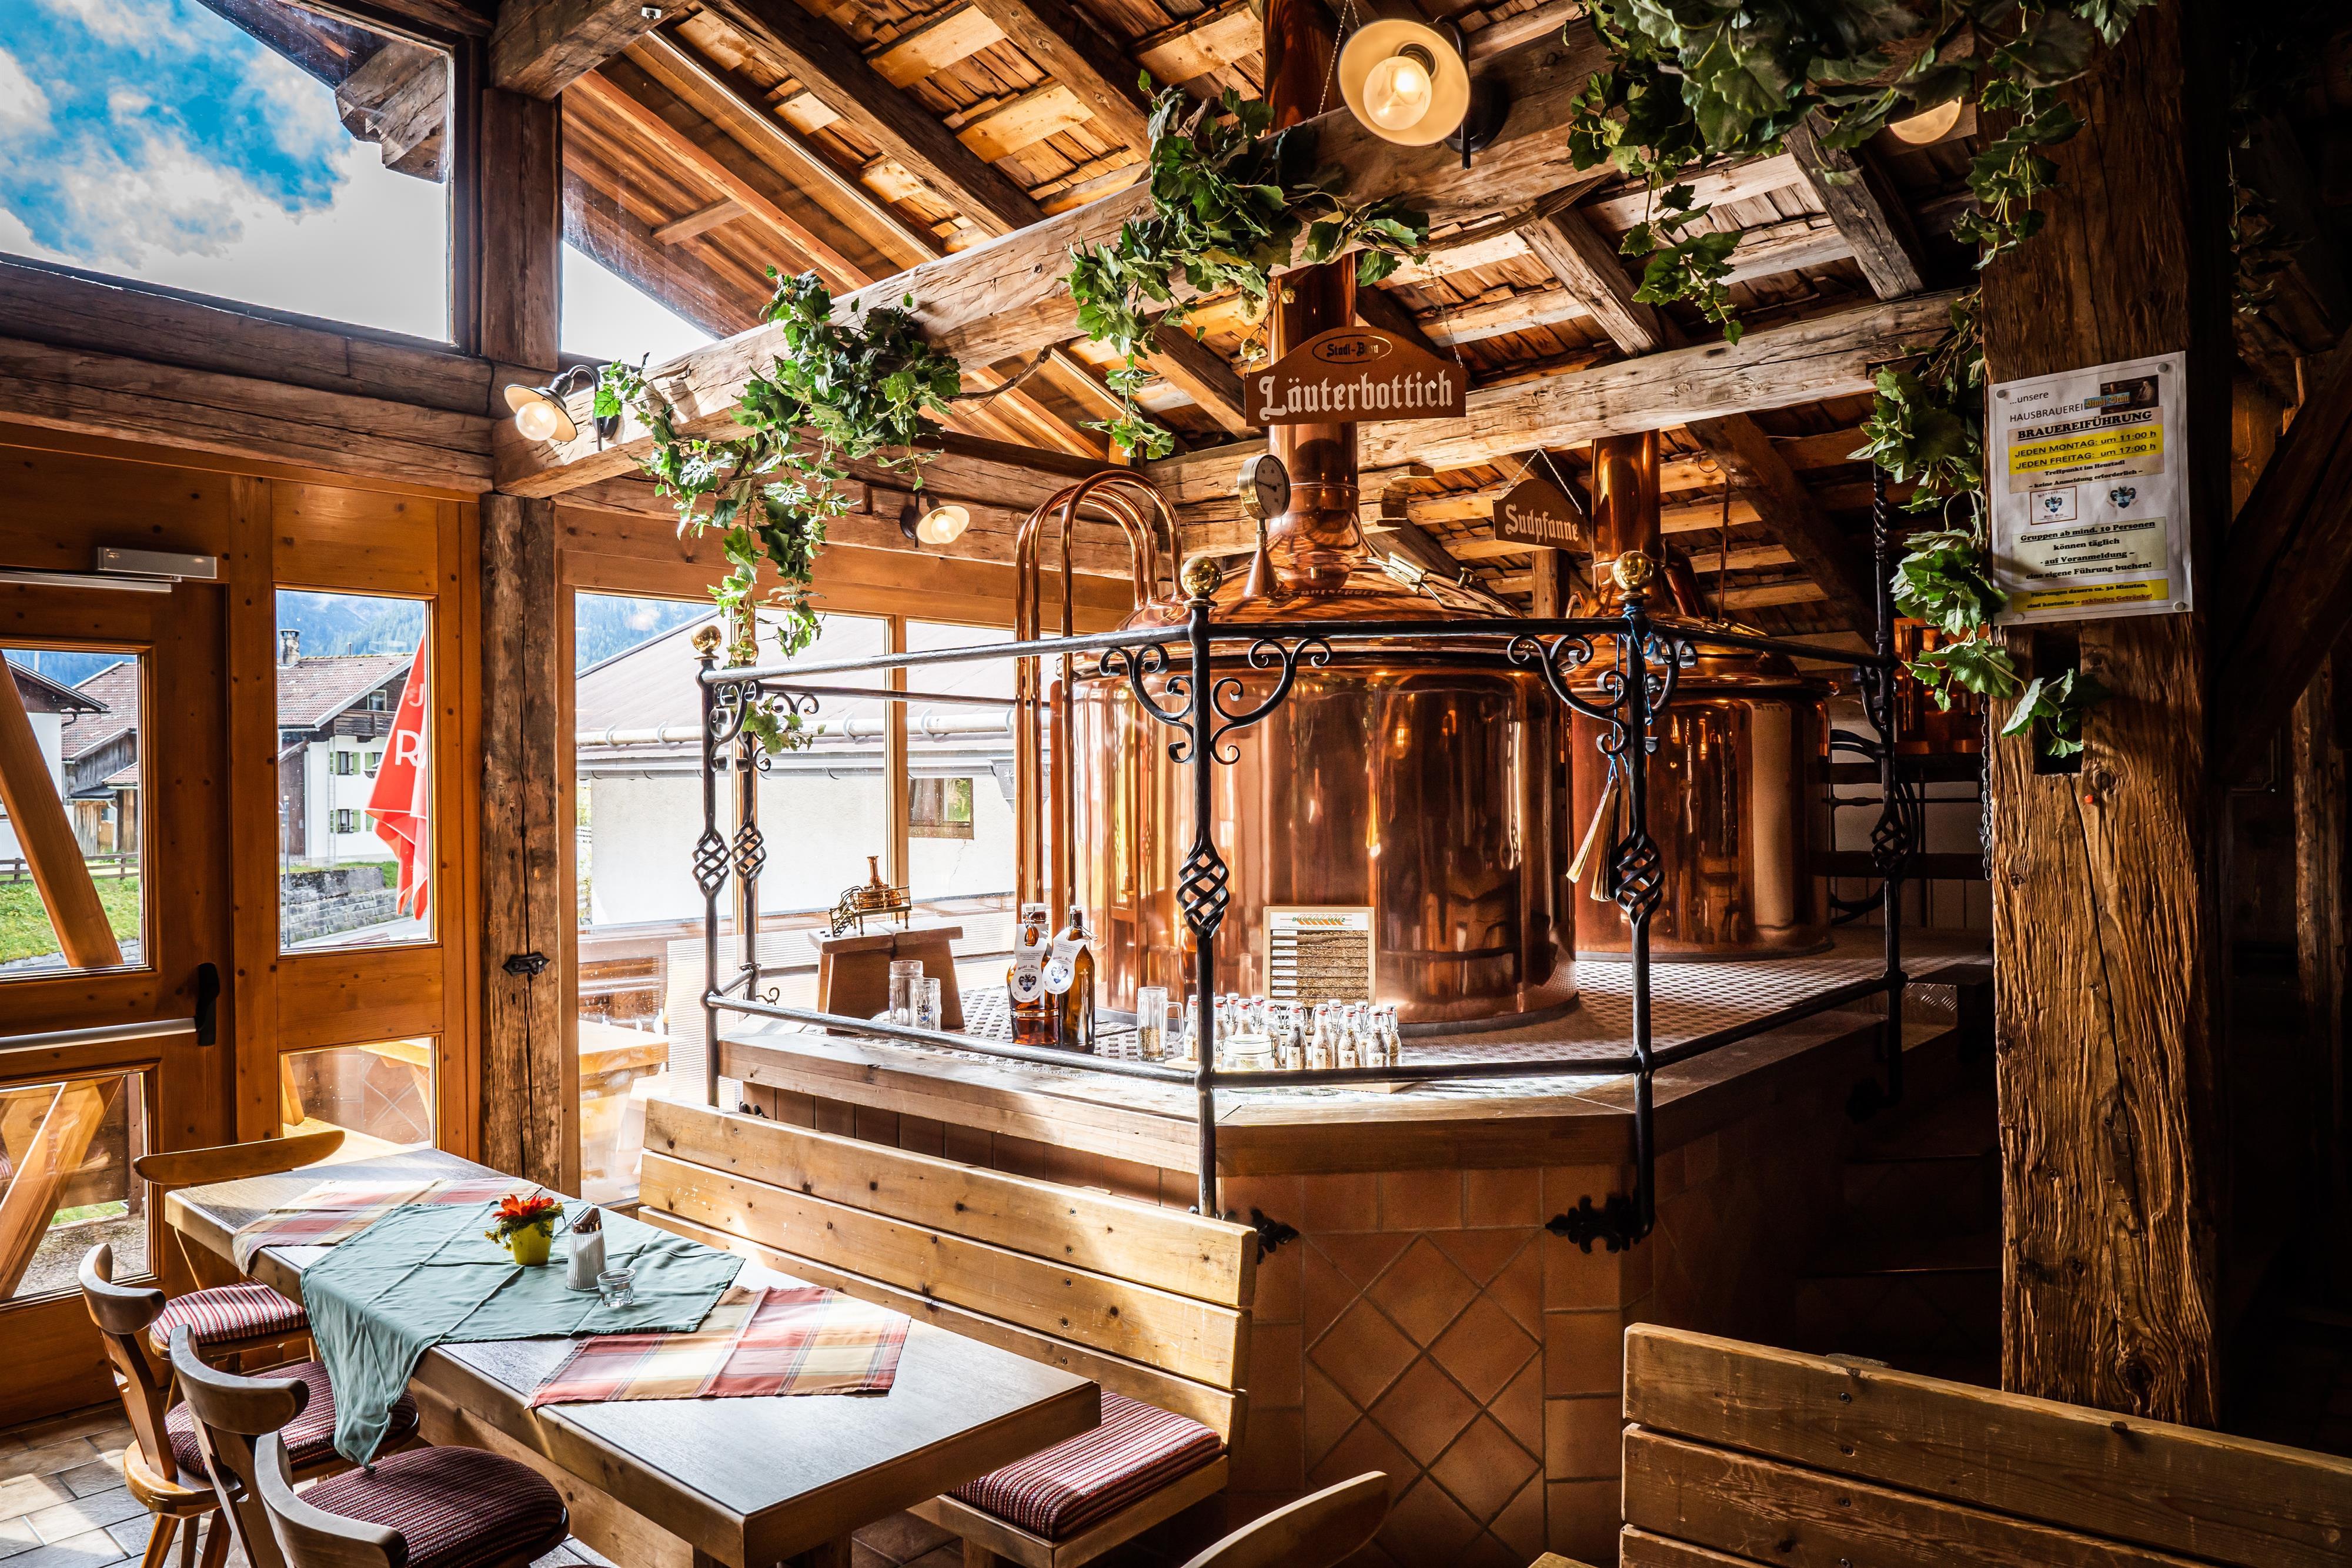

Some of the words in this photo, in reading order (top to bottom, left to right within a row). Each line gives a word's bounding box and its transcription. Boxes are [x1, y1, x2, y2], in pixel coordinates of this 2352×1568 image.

[1327, 342, 1378, 357] Stadl-Bu
[1259, 369, 1452, 420] Läuterbottich
[2009, 403, 2083, 422] HAUSBRAUEREI
[2017, 410, 2152, 440] BRAUEREIFÜHRUNG
[2014, 447, 2046, 457] JEDEN
[2049, 439, 2097, 452] MONTAG:
[2120, 432, 2147, 442] 11:00
[2016, 459, 2047, 469] JEDEN
[2050, 452, 2094, 464] FREITAG:
[2120, 444, 2146, 454] 17:00
[2044, 466, 2083, 476] Treffpunkt
[2094, 460, 2125, 470] Heustadl
[2054, 474, 2093, 486] Anmeldung
[2094, 469, 2137, 480] erforderlich
[1505, 504, 1579, 542] Sudpfanne
[2020, 531, 2058, 541] Gruppen
[2072, 527, 2098, 536] mind.
[2113, 521, 2155, 531] Personen
[2053, 541, 2086, 551] können
[2088, 537, 2120, 548] täglich
[2044, 557, 2060, 565] auf
[2061, 550, 2127, 562] Voranmeldung
[2045, 569, 2072, 579] eigene
[2074, 565, 2113, 575] Führung
[2115, 561, 2152, 571] buchen!
[2081, 596, 2115, 604] exklusive
[2116, 593, 2153, 601] Getränke!
[395, 729, 427, 769] R
